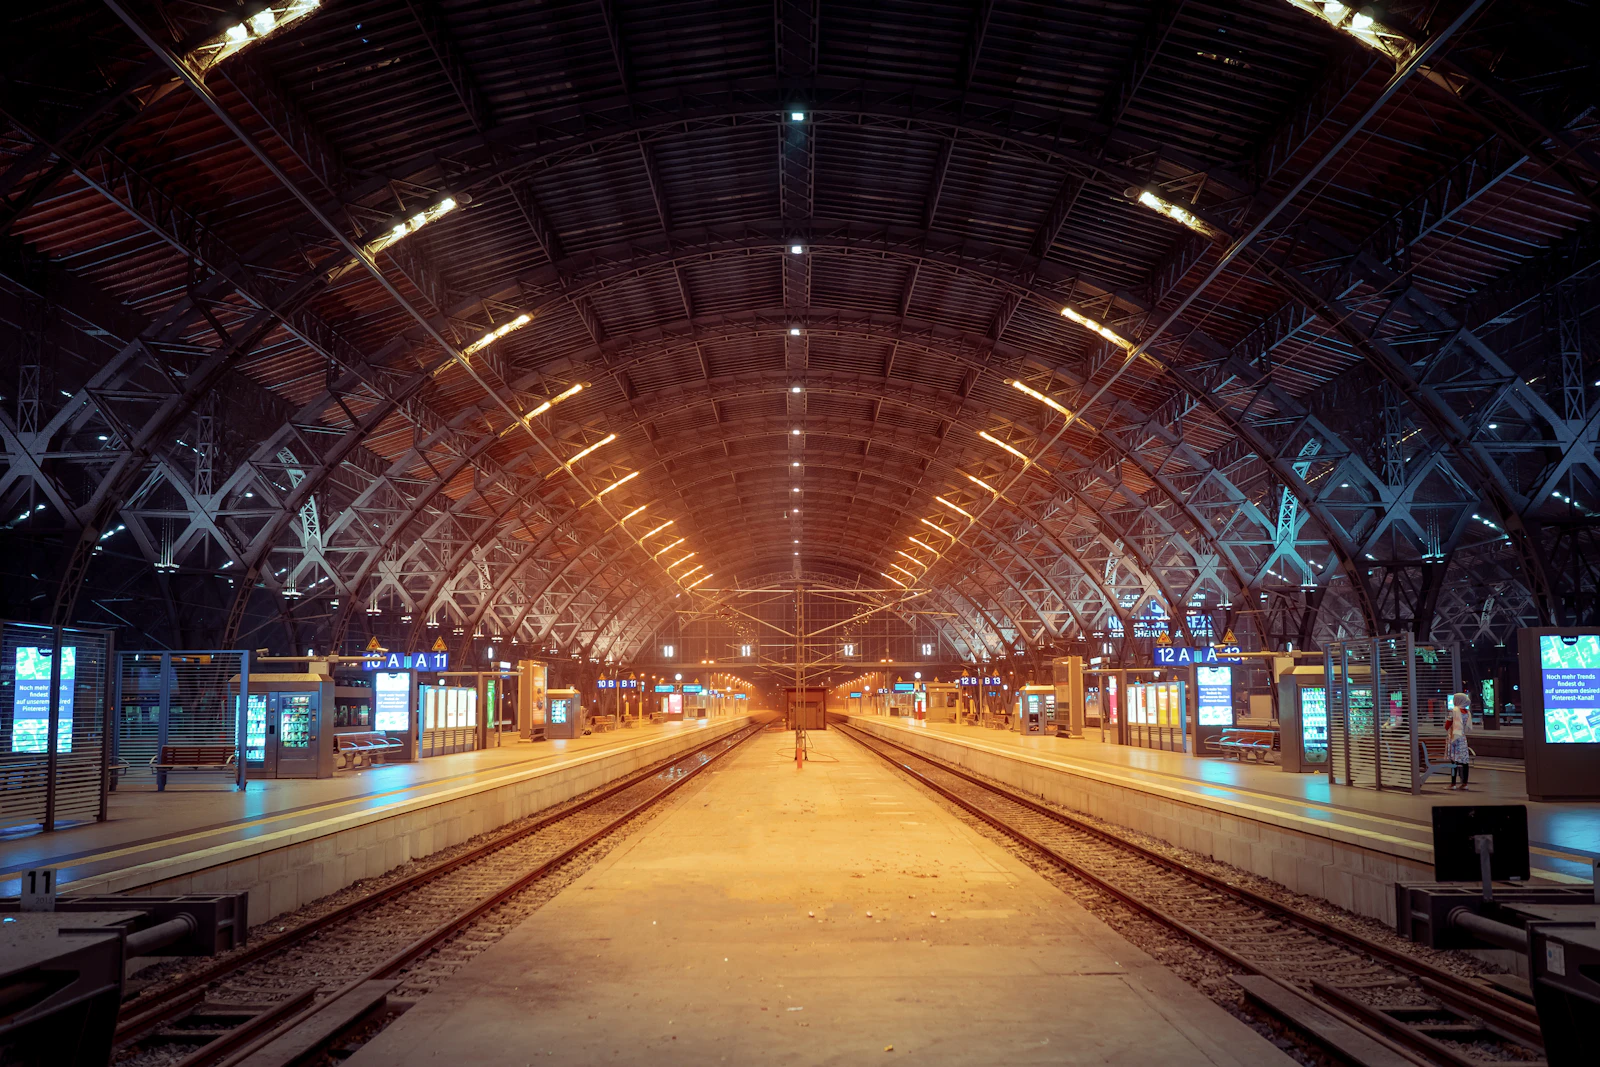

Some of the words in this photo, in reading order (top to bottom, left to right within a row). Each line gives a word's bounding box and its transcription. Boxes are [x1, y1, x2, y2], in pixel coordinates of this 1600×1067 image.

[387, 653, 399, 668] A
[415, 653, 427, 668] A
[434, 653, 447, 668] 11
[1158, 648, 1175, 662] 12
[1178, 648, 1190, 662] A
[1206, 647, 1218, 662] A
[597, 680, 606, 688] 10
[608, 680, 614, 688] B
[621, 680, 628, 688] B
[629, 680, 637, 688] 11
[961, 677, 969, 685] 12
[971, 677, 977, 685] B
[984, 677, 990, 685] B
[993, 677, 1001, 685] 13
[27, 870, 51, 895] 11
